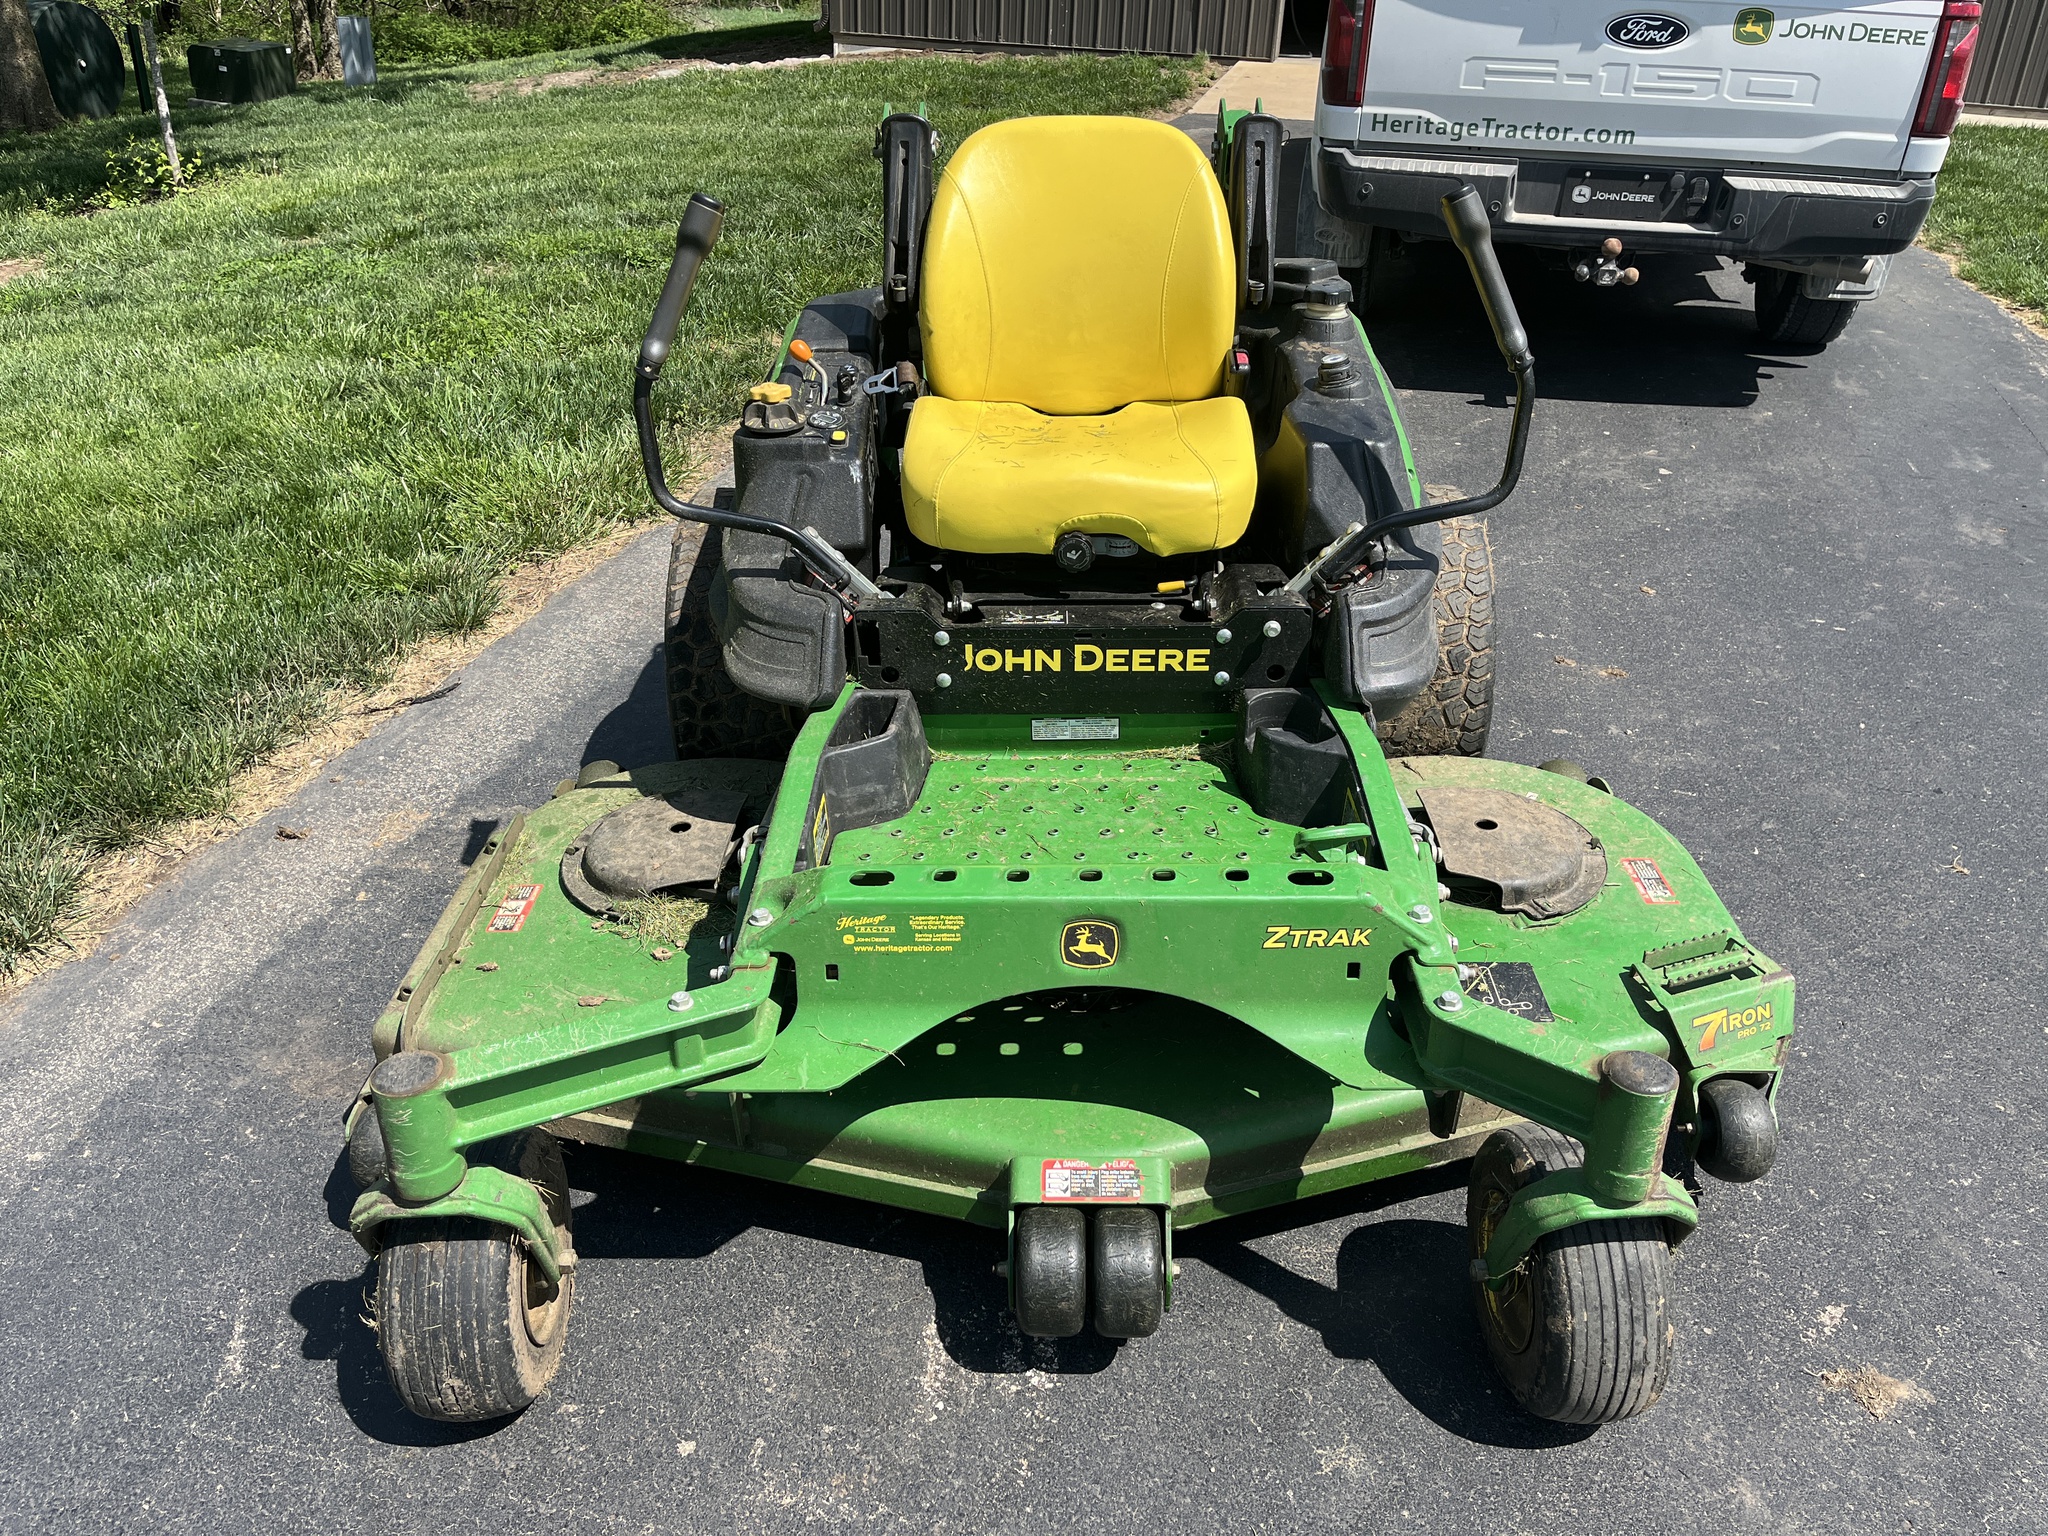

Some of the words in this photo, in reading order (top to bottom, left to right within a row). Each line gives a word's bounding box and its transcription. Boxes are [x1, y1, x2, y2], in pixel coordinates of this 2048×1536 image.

[1619, 18, 1674, 44] Ford
[1779, 18, 1845, 41] JOHN
[1848, 22, 1929, 46] DEERE
[1459, 55, 1821, 107] F-150
[1371, 113, 1635, 145] HeritageTractor.com
[1592, 190, 1620, 201] JOHN
[1620, 191, 1655, 203] DEERE
[964, 643, 1062, 672] JOHN
[1074, 643, 1211, 672] DEERE
[836, 914, 887, 931] Heritage
[853, 944, 953, 953] www.heritagetractor.com
[1262, 925, 1373, 949] ZTRAK
[1737, 1026, 1757, 1040] PRO
[1759, 1021, 1771, 1032] 72
